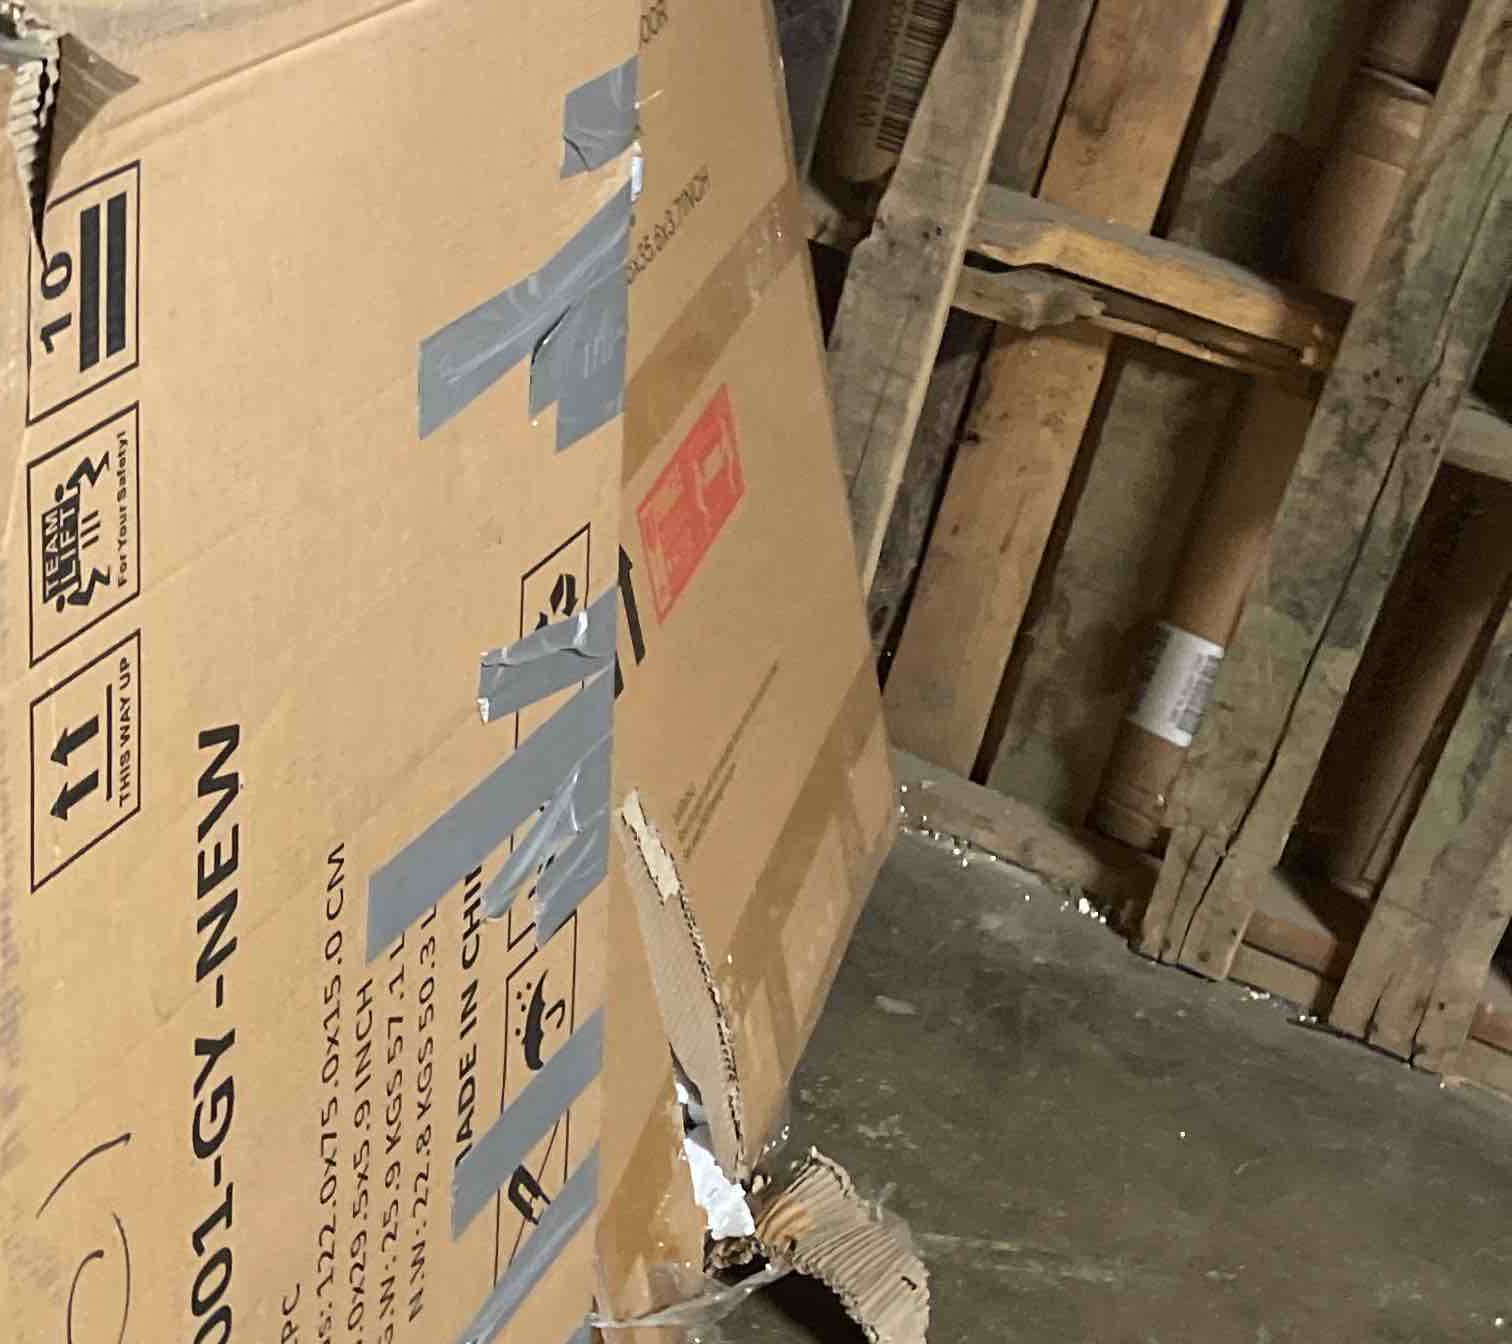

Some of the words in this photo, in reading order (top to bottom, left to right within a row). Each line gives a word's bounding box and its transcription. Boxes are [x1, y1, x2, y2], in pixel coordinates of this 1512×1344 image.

[44, 509, 61, 600] TEAM
[59, 506, 78, 585] LIFT
[117, 505, 129, 551] Your
[117, 554, 129, 588] For
[119, 657, 131, 691] UP
[119, 697, 131, 749] WAY
[119, 750, 131, 809] THIS
[326, 841, 345, 921] CM
[386, 963, 406, 1065] 57.1
[418, 935, 436, 1033] 50.3
[459, 978, 479, 1041] IN
[354, 977, 373, 1094] INCH
[416, 1035, 434, 1121] KGS
[316, 929, 343, 1298] 122.0x75.0x15.0
[385, 1068, 404, 1155] KGS
[382, 1160, 402, 1253] 25.9
[412, 1123, 432, 1219] 22.8
